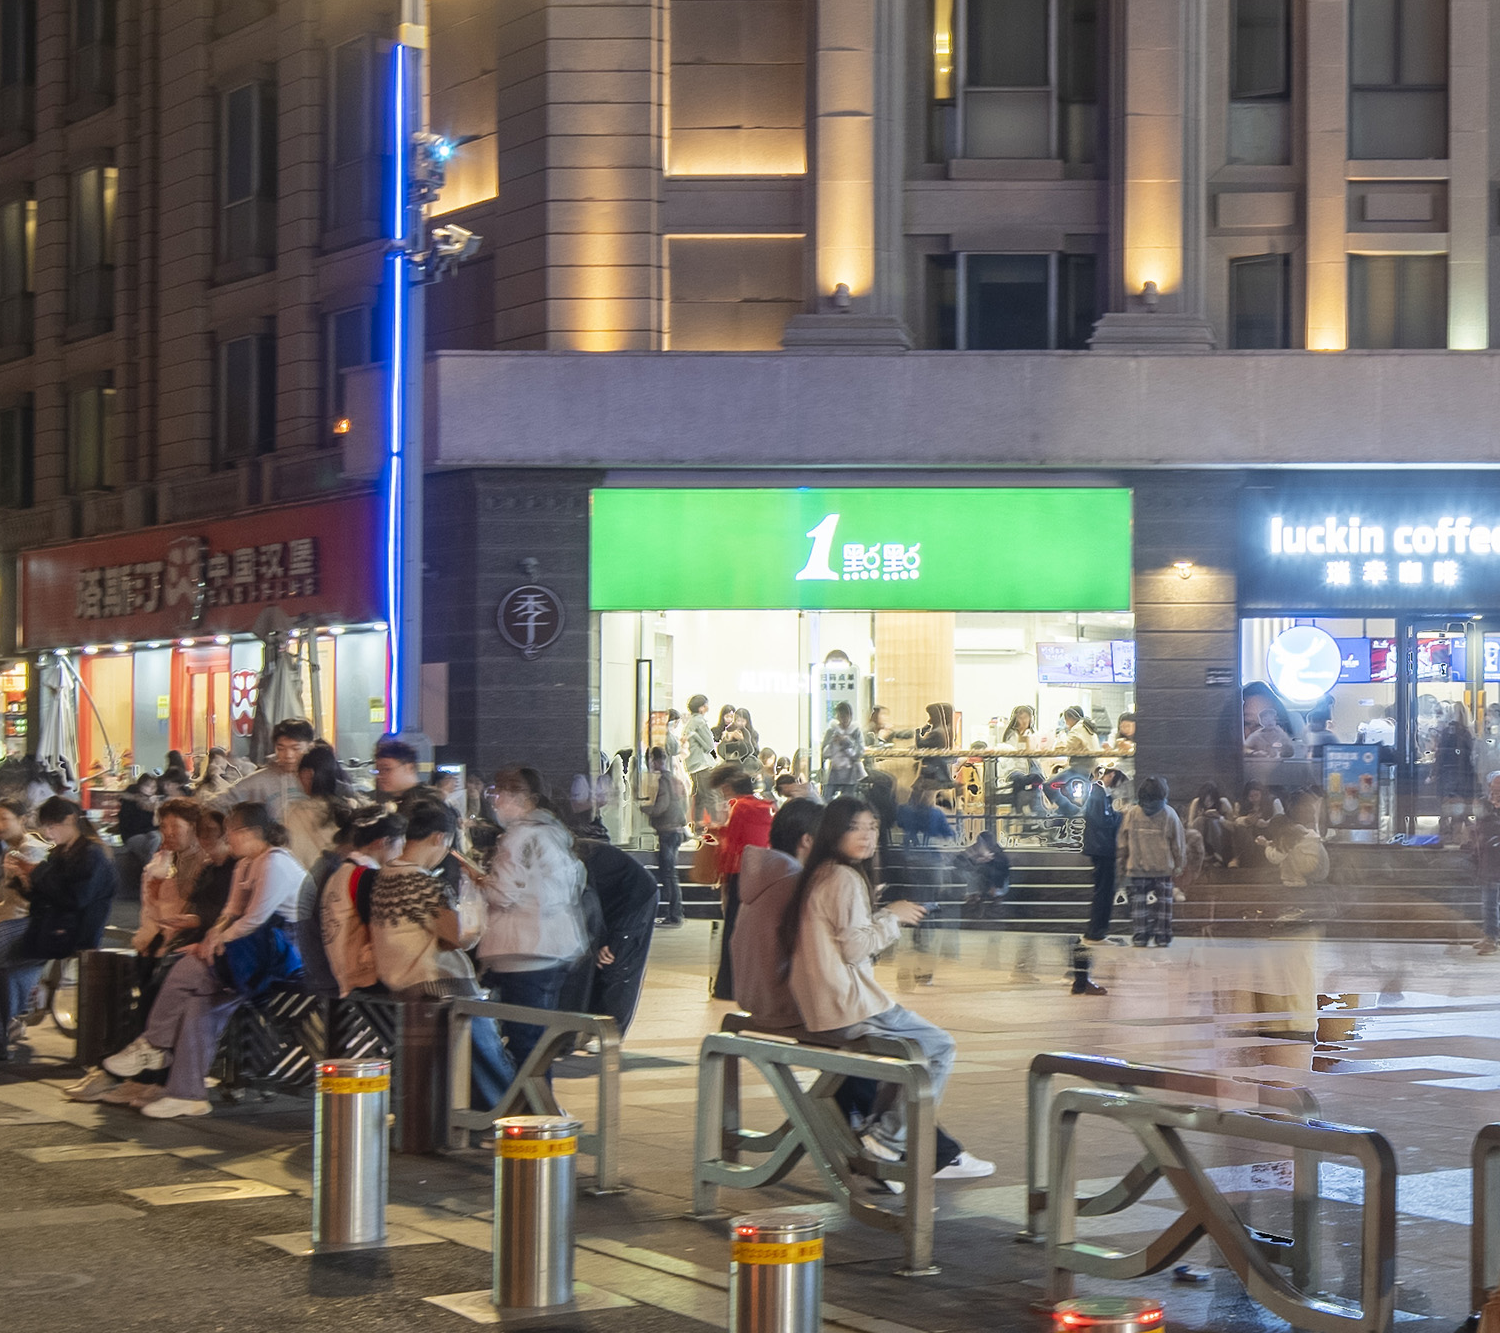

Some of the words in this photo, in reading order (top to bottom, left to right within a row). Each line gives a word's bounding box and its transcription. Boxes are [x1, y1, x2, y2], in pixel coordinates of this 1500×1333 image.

[1271, 517, 1384, 553] luckin
[208, 538, 314, 584] 中国汉堡
[1326, 560, 1458, 585] 瑞幸咖啡
